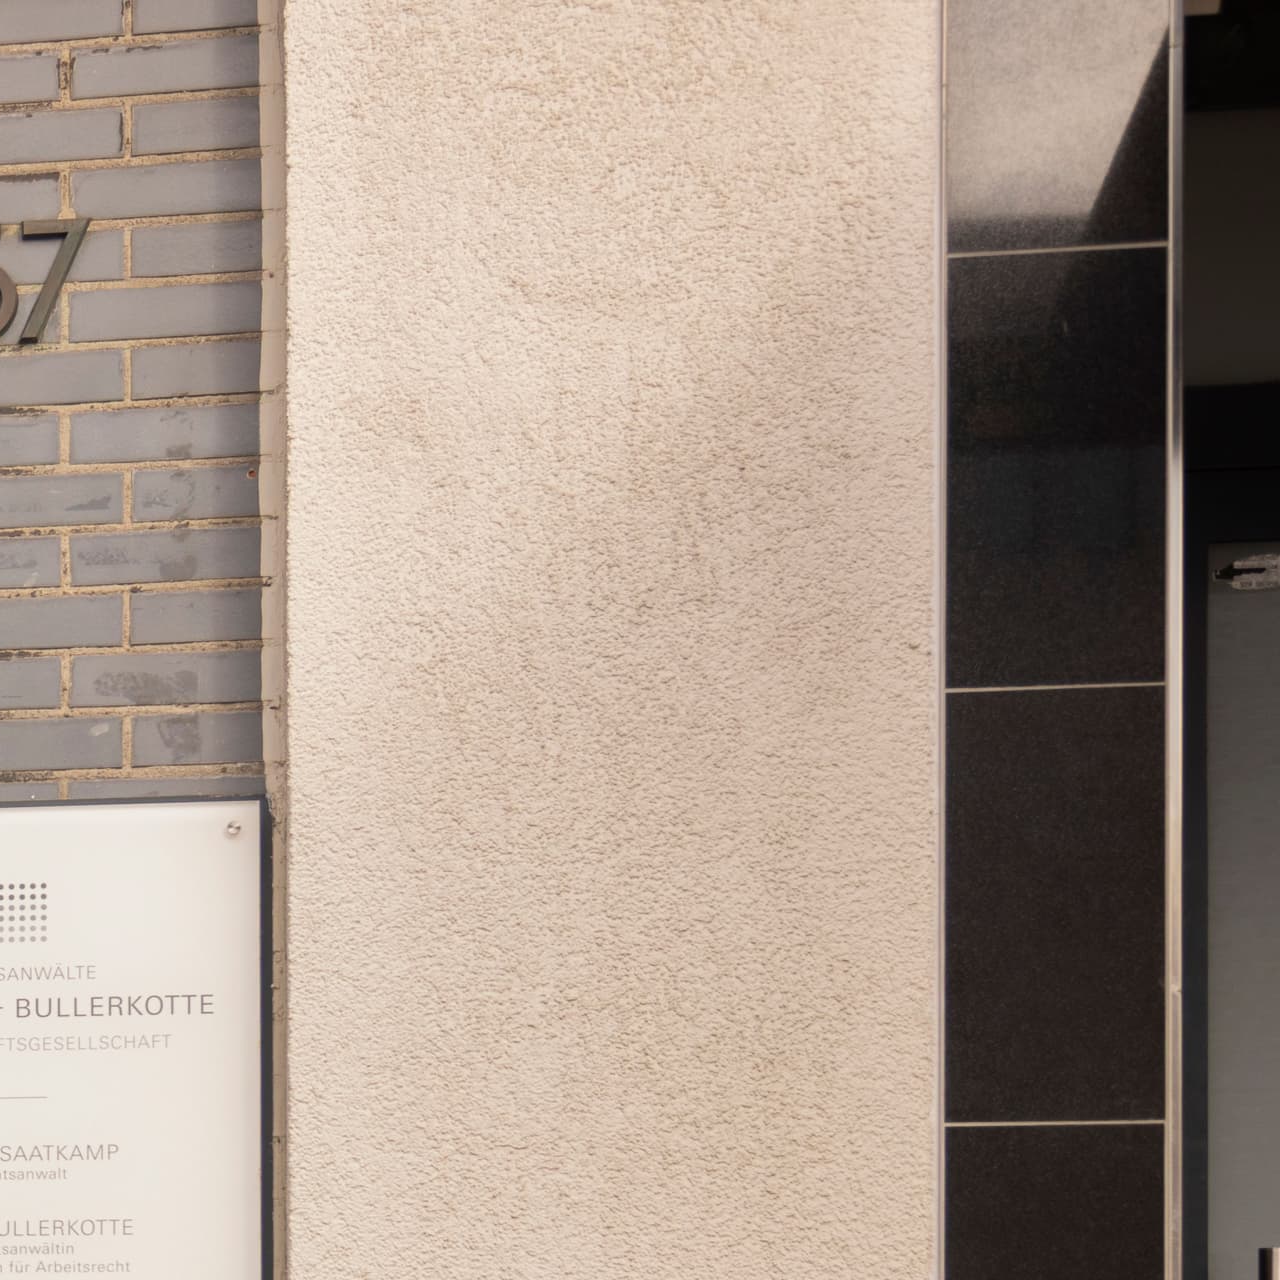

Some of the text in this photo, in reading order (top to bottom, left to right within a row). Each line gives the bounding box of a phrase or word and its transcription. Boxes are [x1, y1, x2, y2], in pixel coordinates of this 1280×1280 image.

[15, 993, 215, 1019] BULLERKOTTE
[0, 1143, 119, 1163] SAATKAMP
[9, 1259, 31, 1274] für
[34, 1259, 131, 1273] Arbeitsrecht
